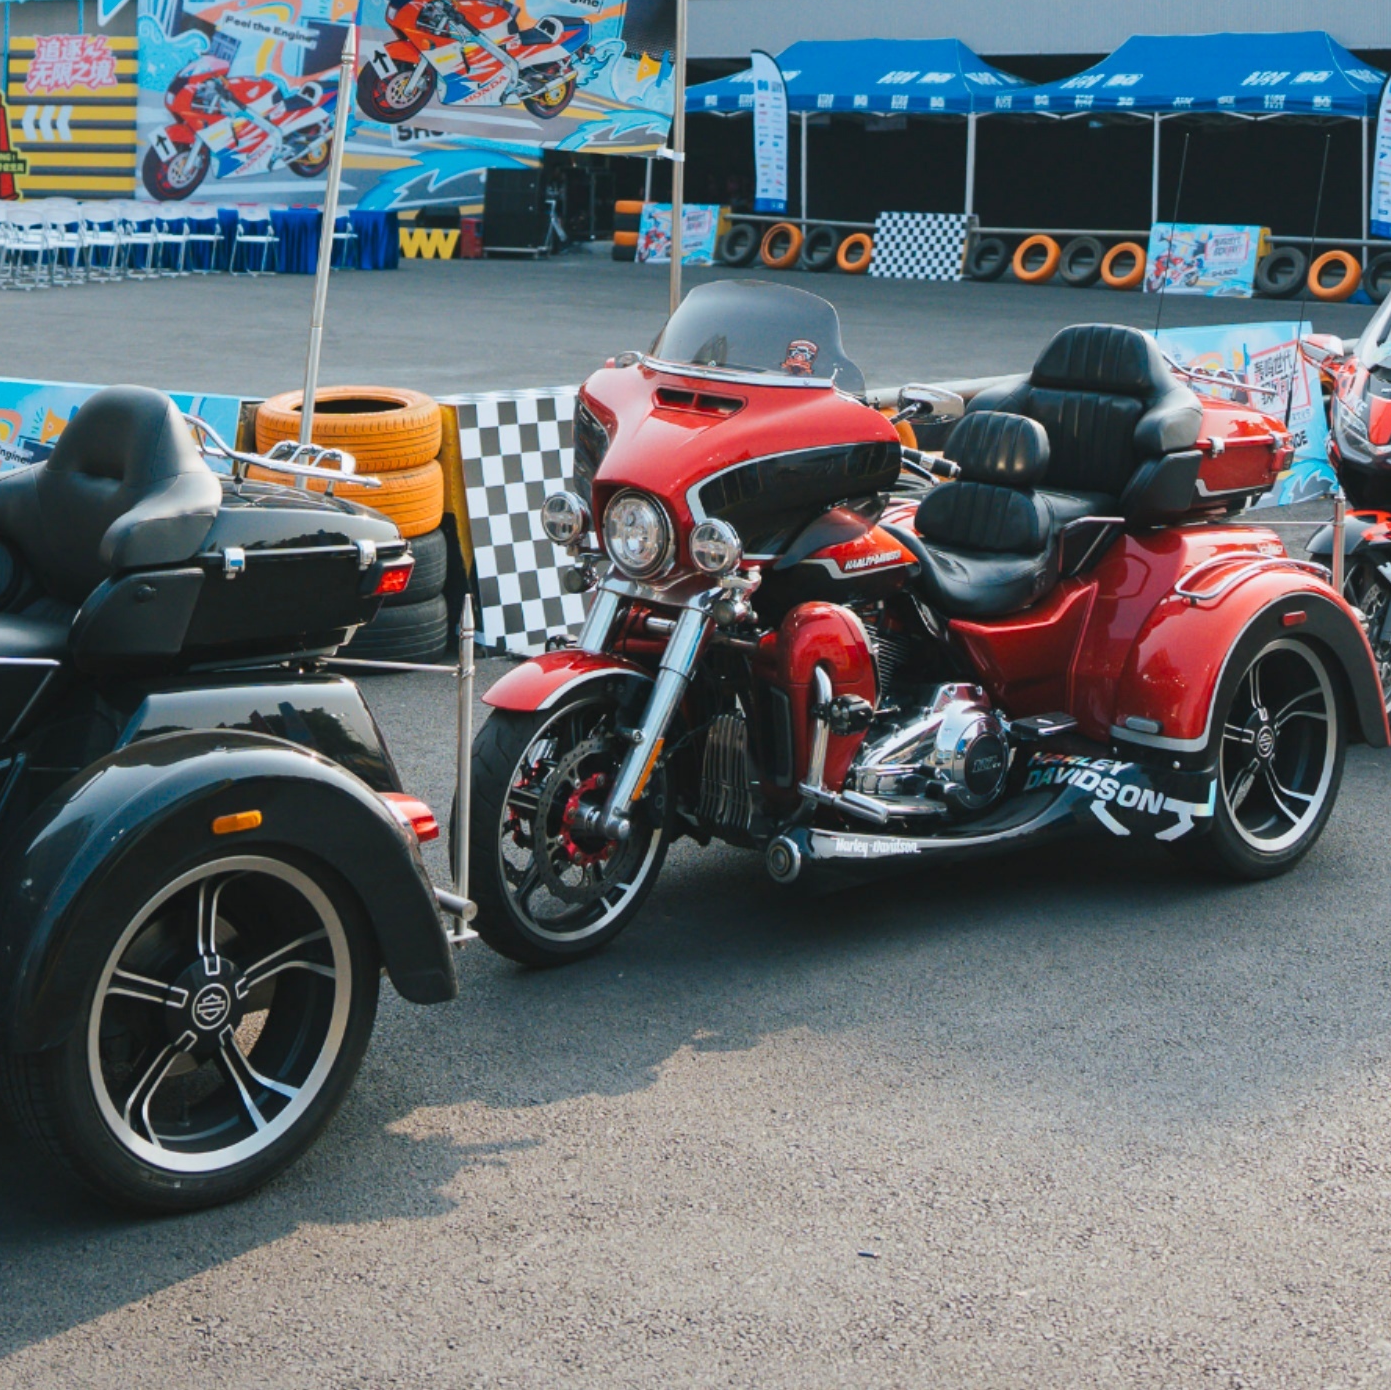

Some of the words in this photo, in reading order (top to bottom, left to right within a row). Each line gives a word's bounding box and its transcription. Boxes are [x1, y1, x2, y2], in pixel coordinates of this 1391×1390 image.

[225, 15, 253, 30] Feel
[253, 22, 271, 35] the
[273, 25, 317, 43] Engine
[38, 38, 84, 61] 追逐
[31, 60, 113, 90] 无限之境
[463, 75, 508, 104] HONDA
[1028, 750, 1135, 777] HARLEY
[1023, 766, 1169, 816] DAVIDSON
